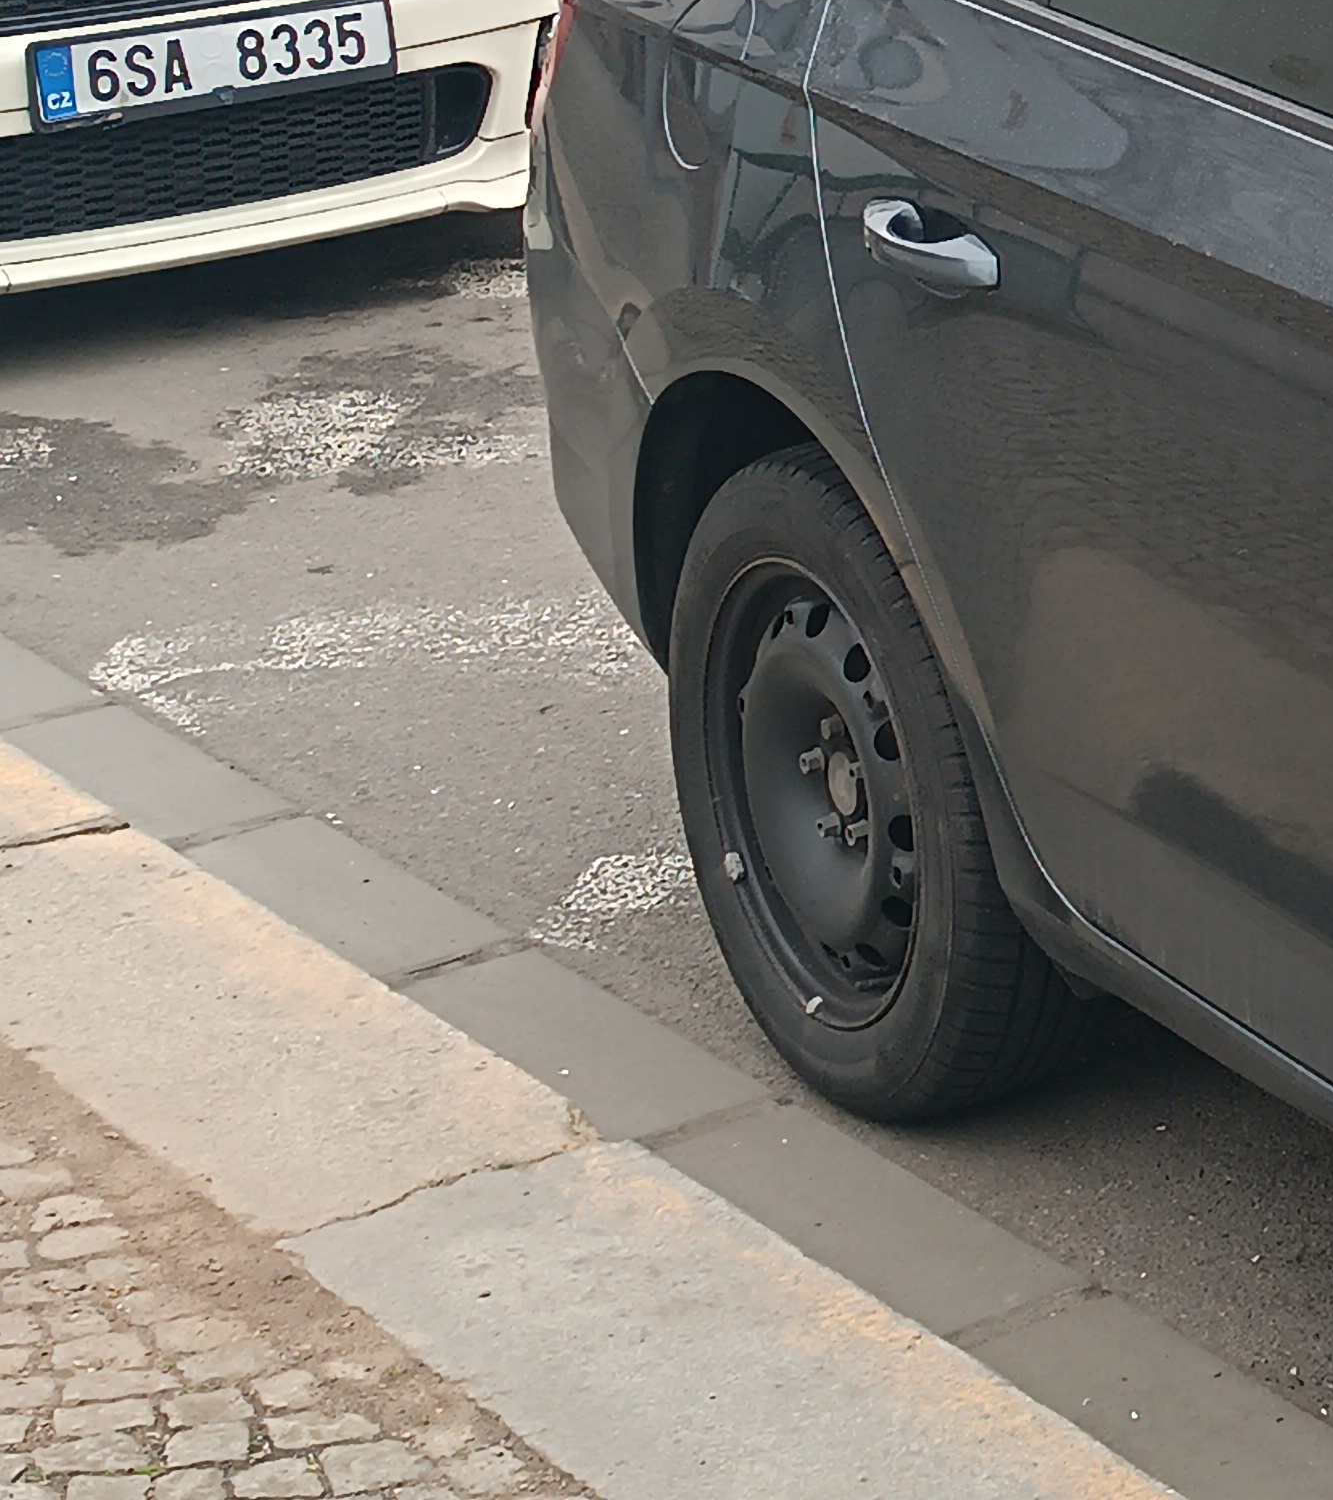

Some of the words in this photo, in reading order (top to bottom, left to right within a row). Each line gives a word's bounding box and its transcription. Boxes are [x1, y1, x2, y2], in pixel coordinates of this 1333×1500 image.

[86, 38, 194, 102] 6SA
[236, 12, 367, 81] 8335
[46, 92, 73, 110] CZ
